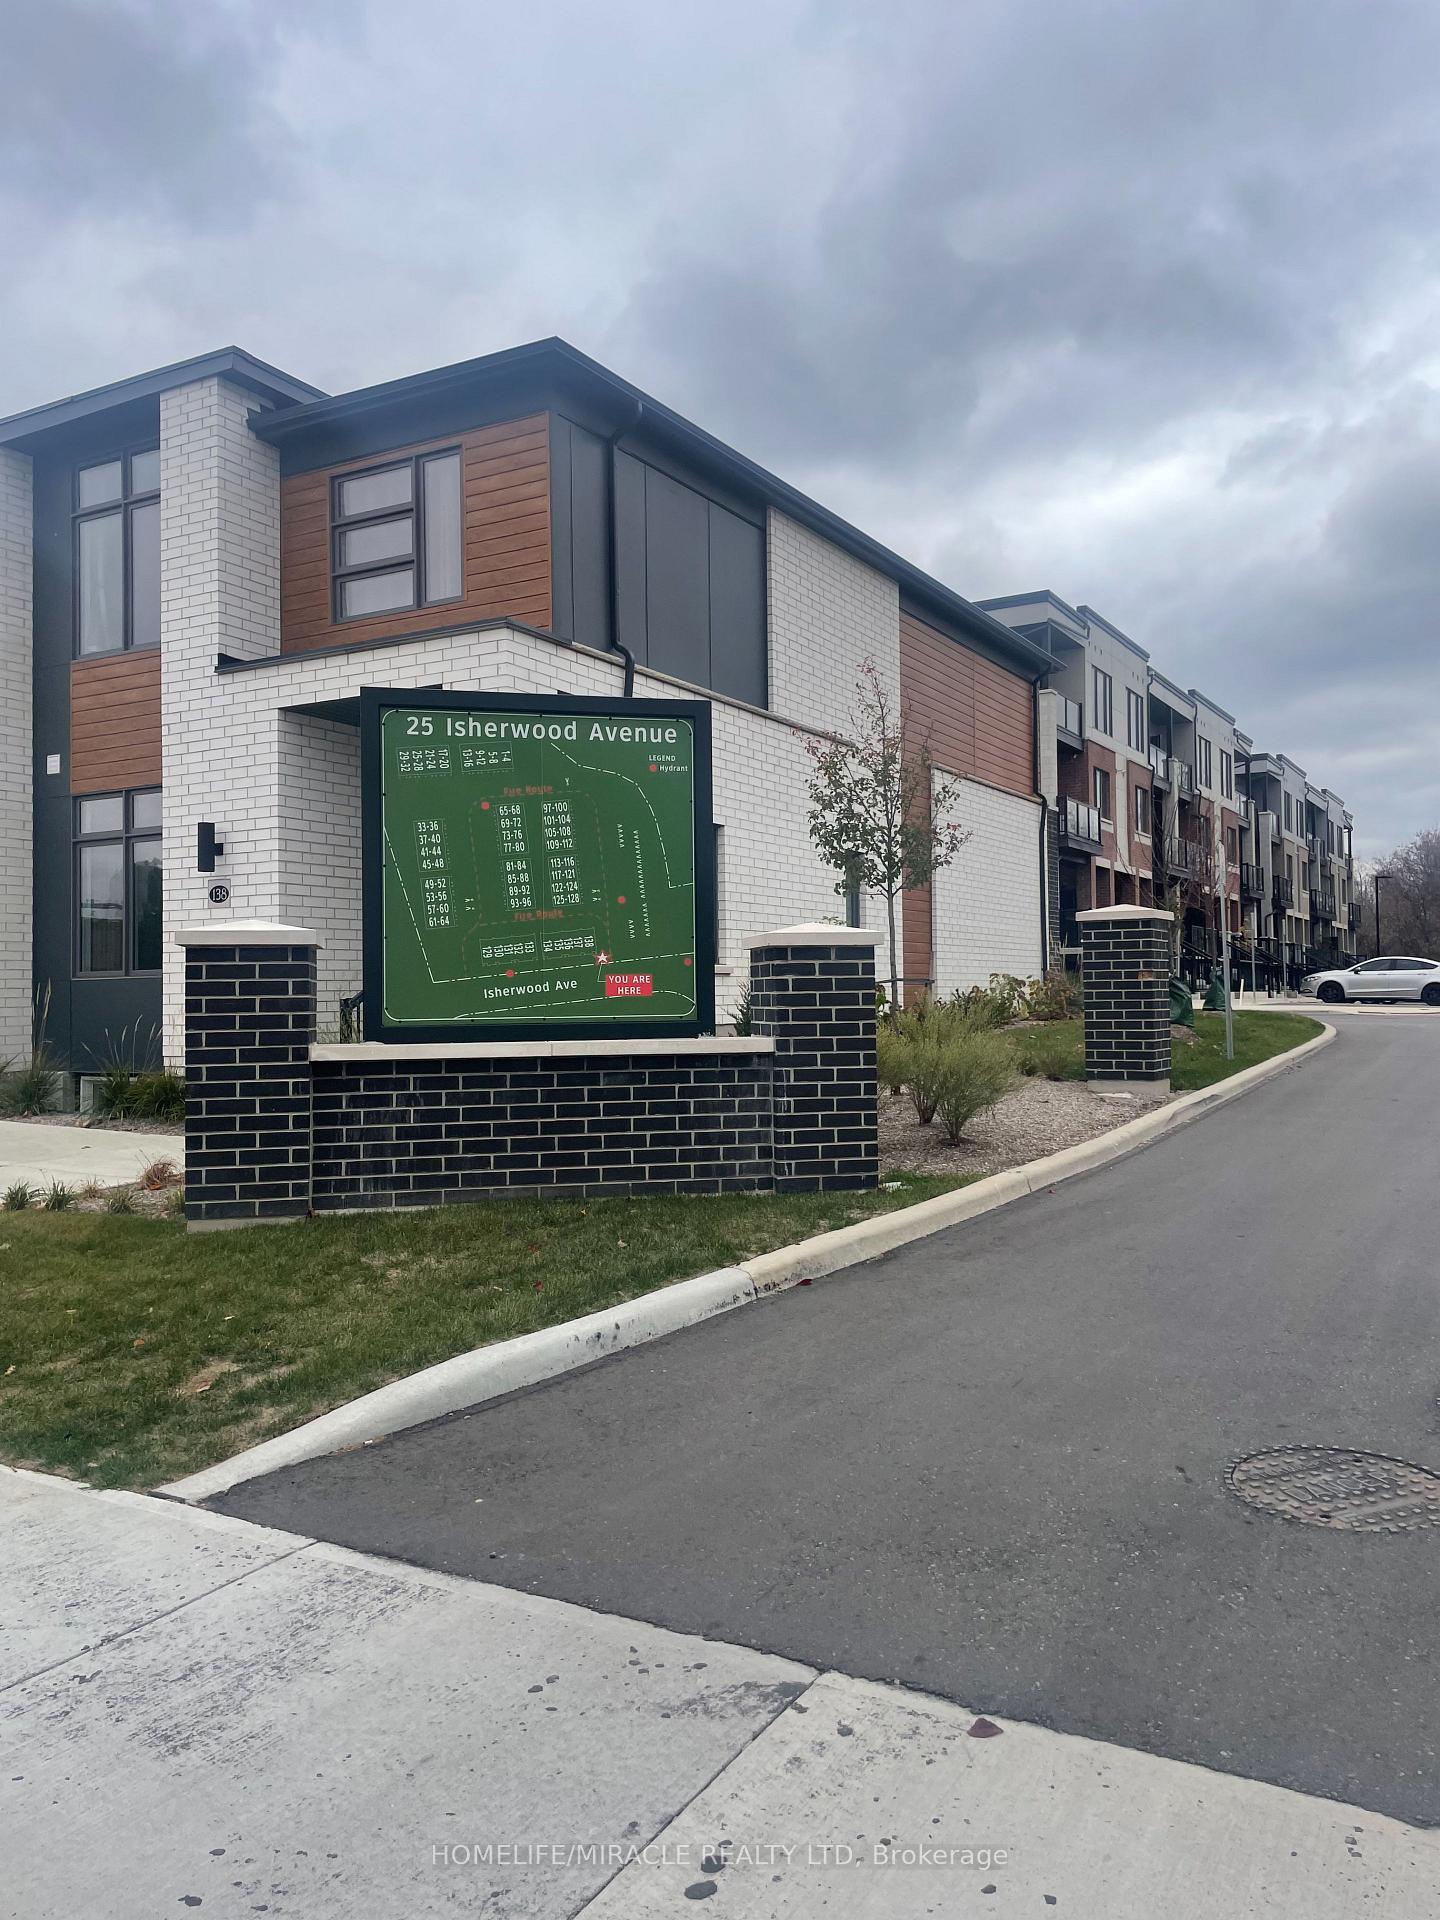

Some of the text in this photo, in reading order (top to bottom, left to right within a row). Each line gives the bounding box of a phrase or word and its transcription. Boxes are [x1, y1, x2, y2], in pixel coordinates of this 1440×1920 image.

[406, 716, 678, 744] 25 Isherwood Avenue
[399, 751, 411, 772] 29-32
[412, 750, 424, 771] 25-28
[425, 749, 437, 769] 21-24
[438, 748, 450, 769] 17-20
[462, 748, 474, 768] 13-16
[475, 750, 486, 766] 9-12
[488, 751, 499, 764] 5-8
[501, 750, 512, 762] 1-4
[648, 754, 676, 763] LEGEND
[659, 763, 688, 773] Hydrant
[499, 804, 521, 816] 65-68
[542, 801, 568, 813] 97-100
[417, 820, 439, 832] 33-36
[500, 817, 522, 828] 69-72
[543, 814, 571, 826] 101-104
[502, 829, 523, 841] 73-76
[545, 826, 572, 838] 105-108
[418, 833, 441, 845] 37-40
[546, 838, 573, 850] 109-112
[420, 846, 442, 857] 41-44
[503, 841, 525, 853] 77-80
[422, 858, 445, 869] 45-48
[505, 860, 527, 872] 81-84
[550, 856, 575, 868] 113-116
[507, 872, 530, 884] 85-88
[551, 869, 576, 881] 117-121
[424, 878, 447, 889] 49-52
[551, 881, 578, 893] 122-124
[212, 887, 228, 901] 138
[508, 884, 531, 896] 89-92
[425, 891, 448, 902] 53-56
[510, 896, 532, 908] 93-96
[553, 893, 580, 905] 125-128
[427, 903, 449, 915] 57-60
[428, 915, 450, 927] 61-64
[524, 941, 535, 953] 133
[543, 940, 553, 952] 134
[554, 938, 564, 951] 135
[563, 937, 574, 950] 136
[573, 936, 584, 948] 137
[584, 935, 595, 948] 138
[482, 945, 493, 959] 129
[493, 944, 504, 958] 130
[503, 943, 514, 955] 131
[513, 942, 524, 955] 132
[608, 975, 651, 984] YOU ARE
[483, 979, 578, 999] Isherwood Ave
[617, 986, 641, 995] HERE
